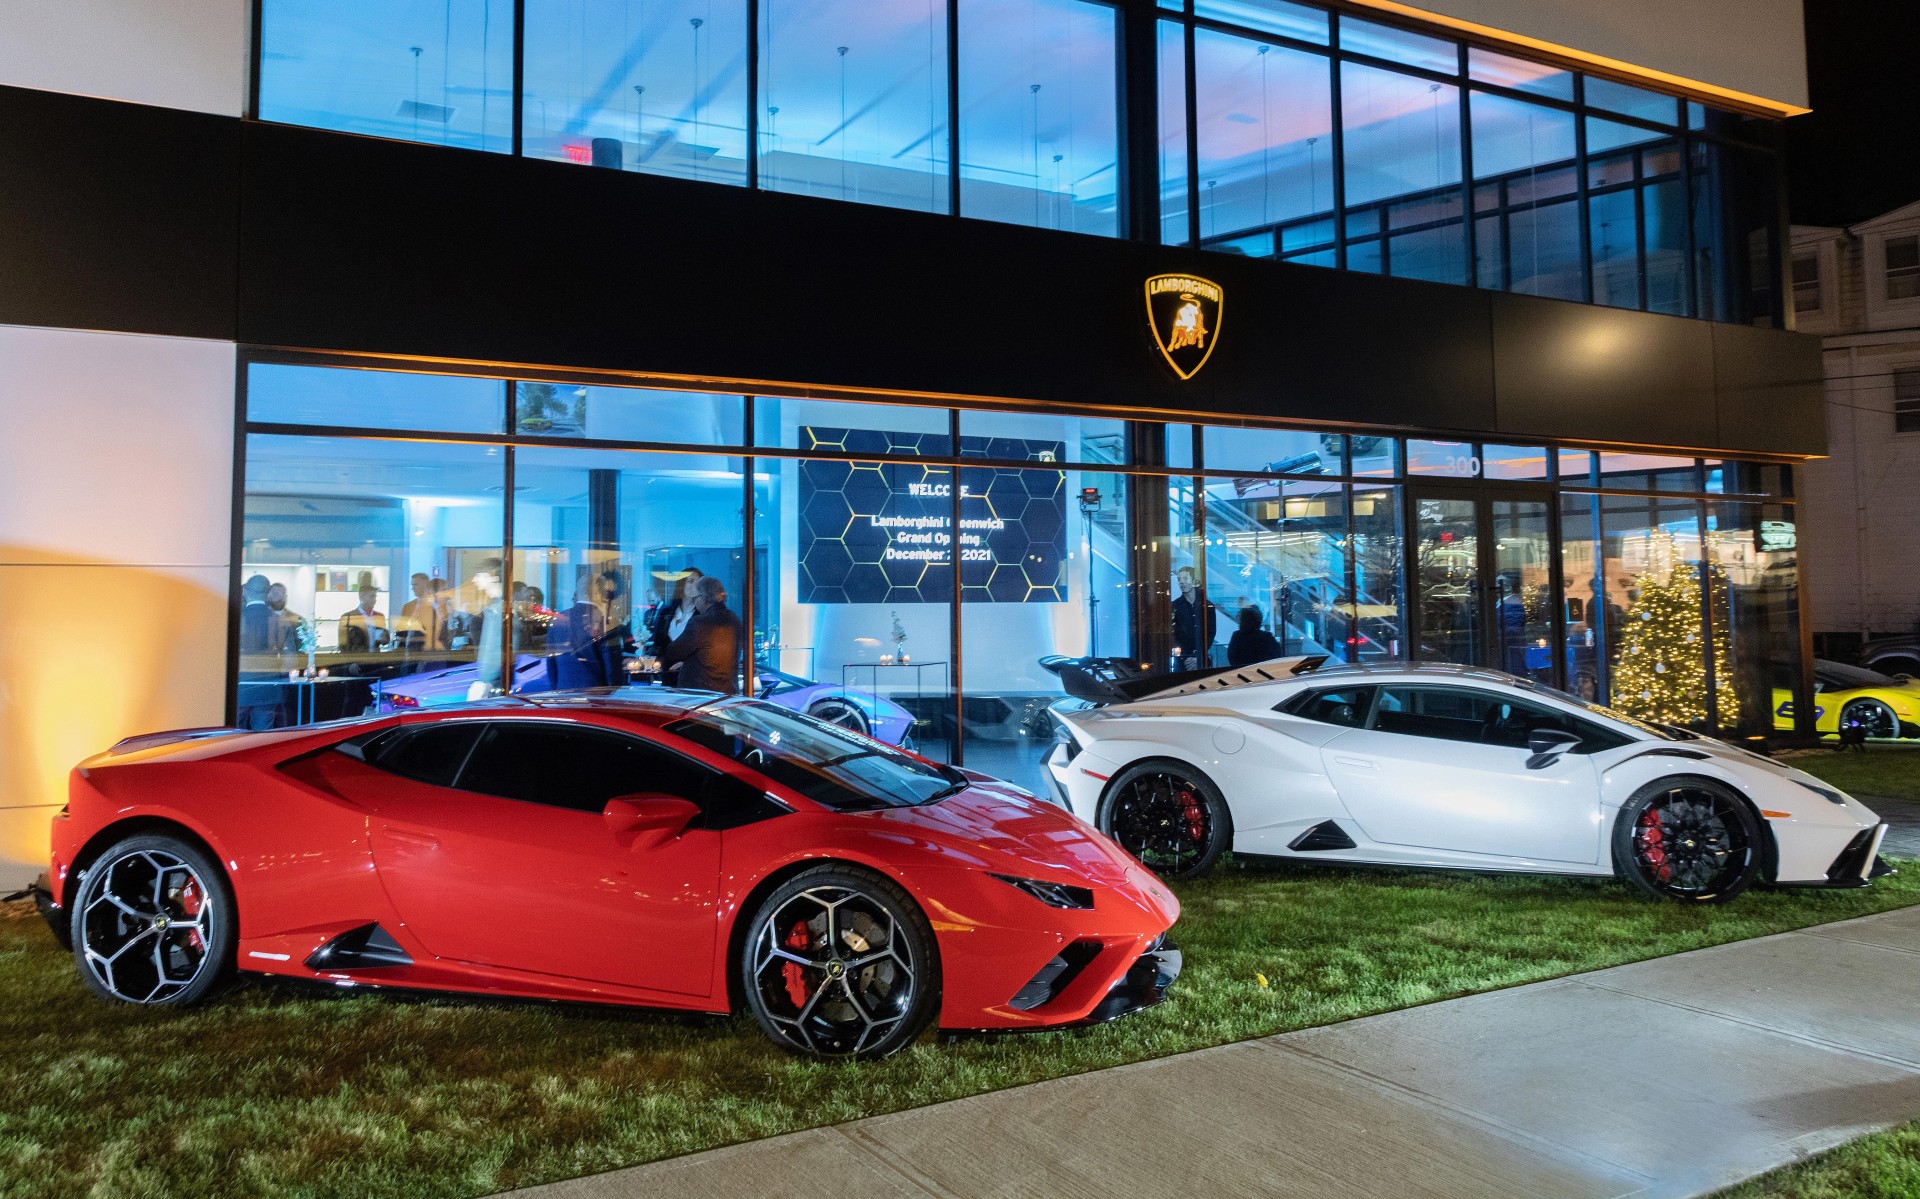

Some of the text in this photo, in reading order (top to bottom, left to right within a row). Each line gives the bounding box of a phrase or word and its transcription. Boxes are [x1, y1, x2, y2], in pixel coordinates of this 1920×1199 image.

[1150, 278, 1218, 302] LAMBORGHINI
[1445, 456, 1481, 476] 300
[909, 483, 969, 497] WELCOE
[871, 515, 1004, 530] Lamborghini eenwich
[897, 531, 981, 546] Grand Oping
[886, 548, 945, 560] December
[962, 549, 991, 560] 2021
